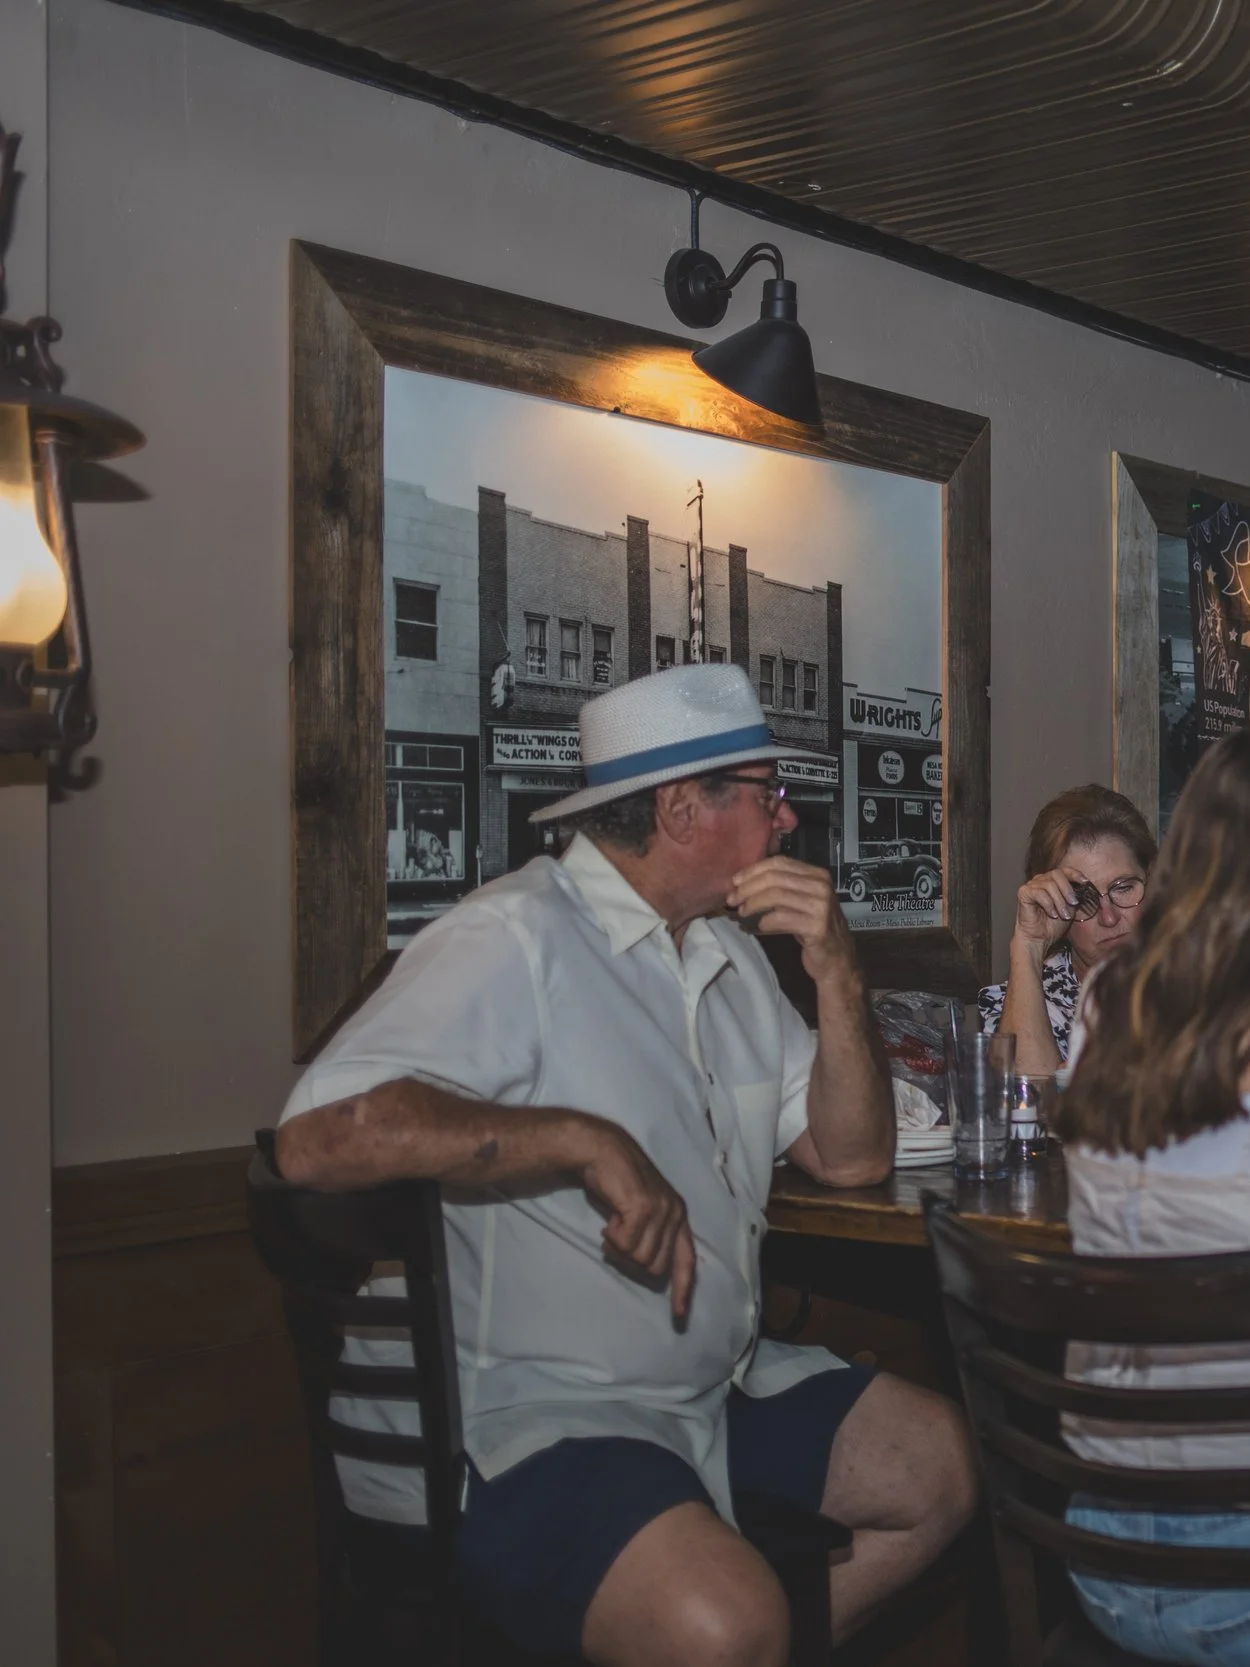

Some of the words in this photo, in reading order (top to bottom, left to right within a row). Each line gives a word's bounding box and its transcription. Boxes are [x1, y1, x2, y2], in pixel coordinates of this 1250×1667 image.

[850, 698, 921, 731] WRIGHTS
[1203, 699, 1214, 713] US
[1213, 700, 1246, 719] Population
[511, 748, 547, 760] ACTION
[871, 893, 895, 912] Nile
[897, 893, 936, 912] Theatre
